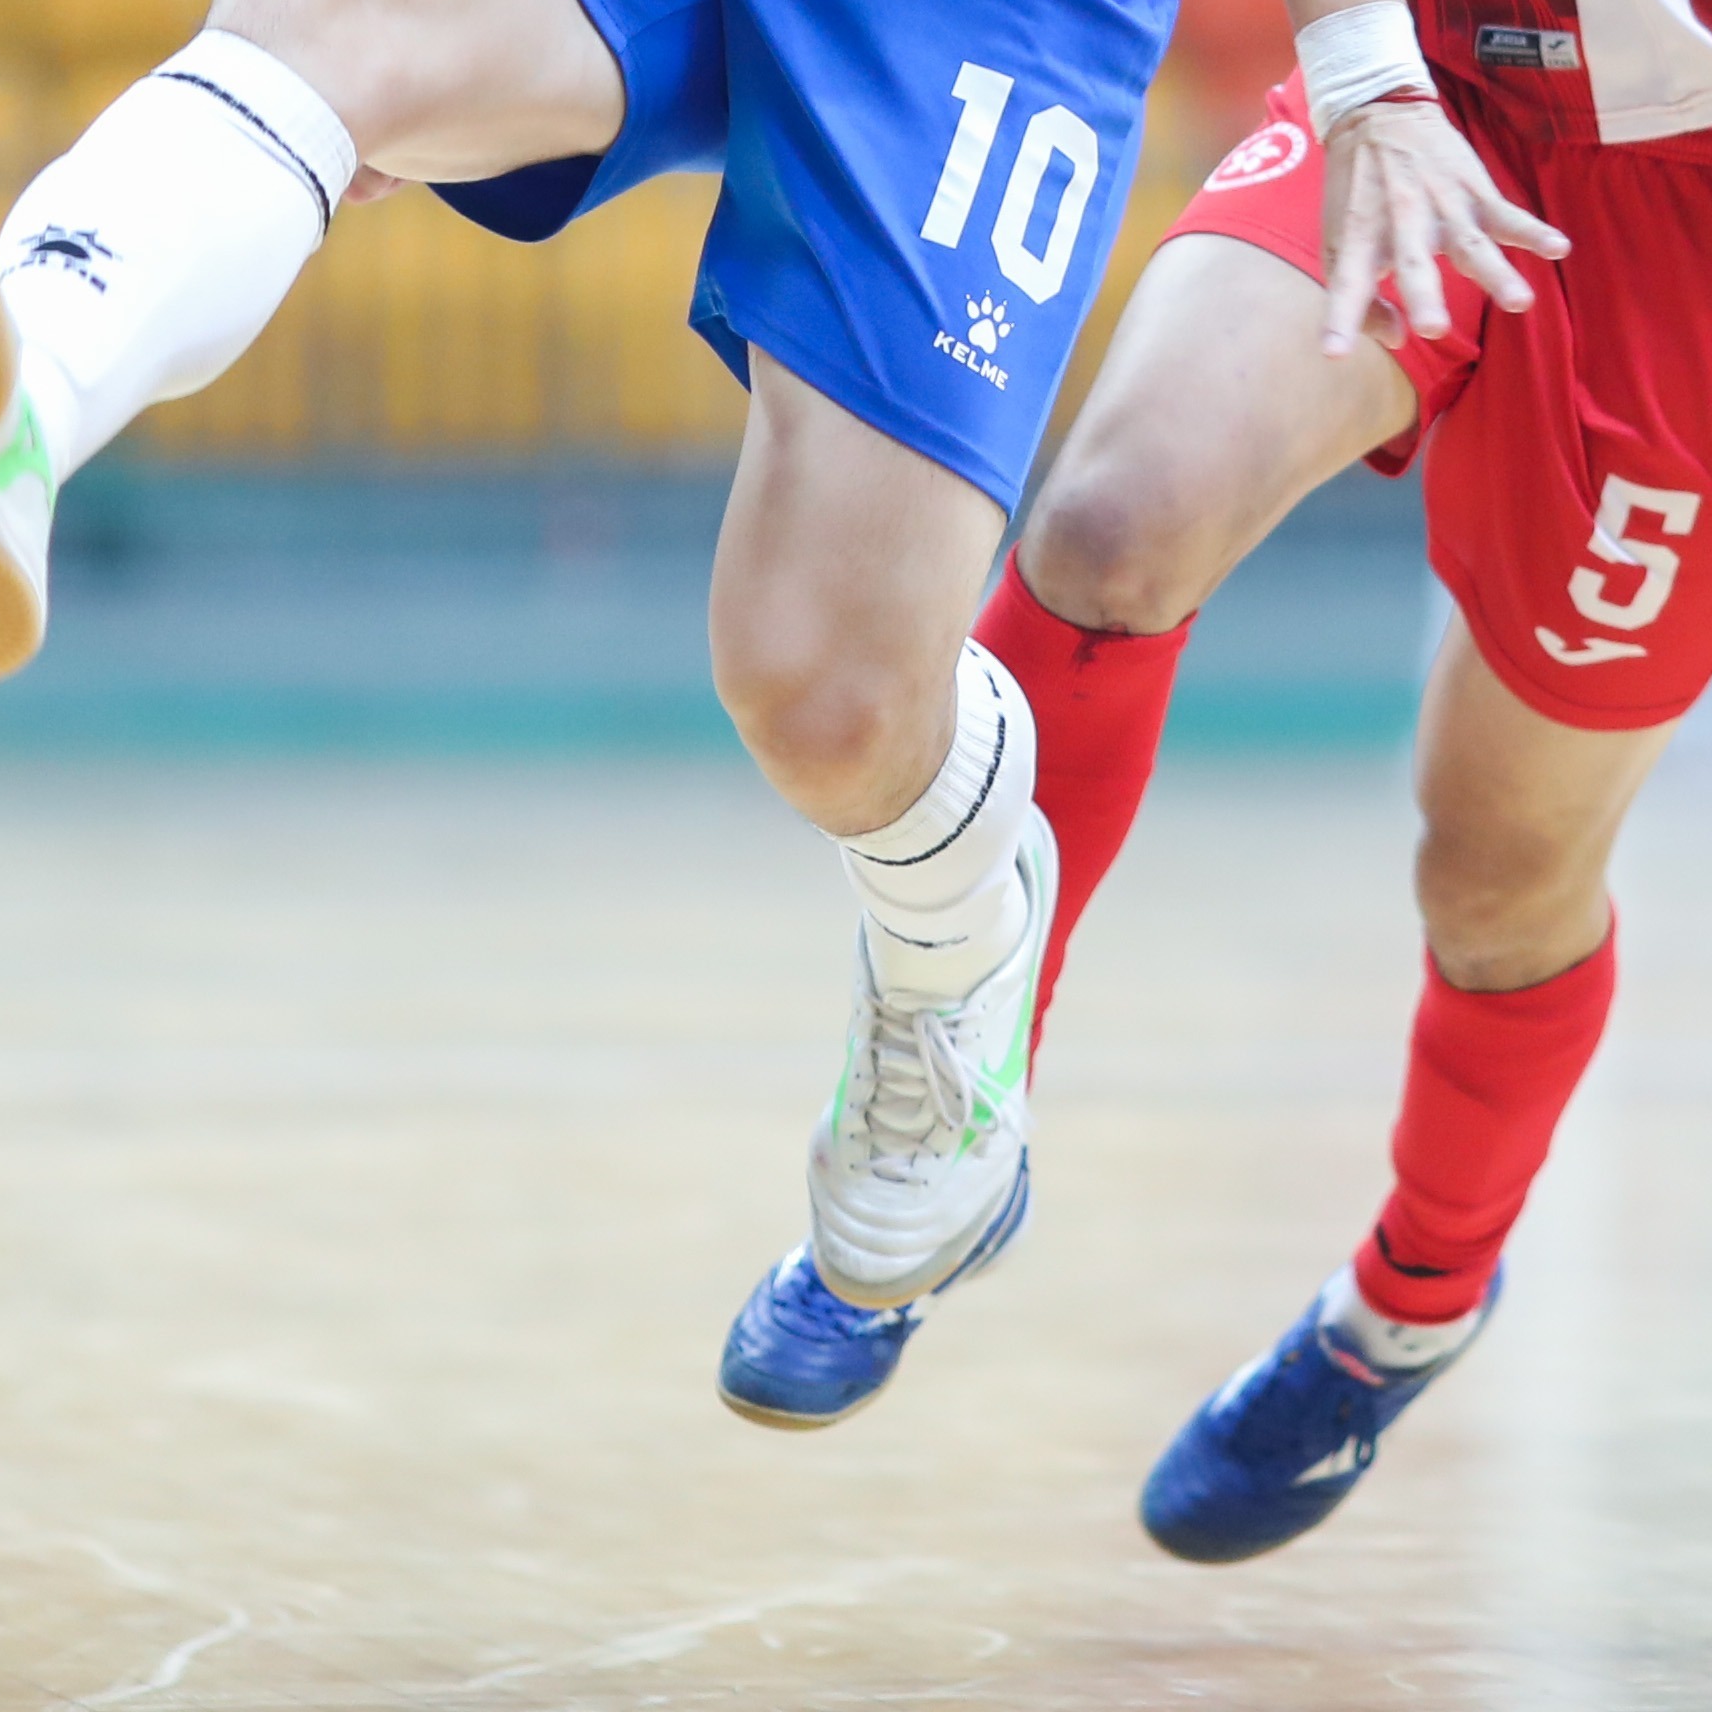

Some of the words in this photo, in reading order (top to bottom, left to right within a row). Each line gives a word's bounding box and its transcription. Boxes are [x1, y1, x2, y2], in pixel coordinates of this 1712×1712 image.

[919, 60, 1100, 305] 10
[932, 330, 1010, 392] KELME
[1566, 473, 1702, 632] 5
